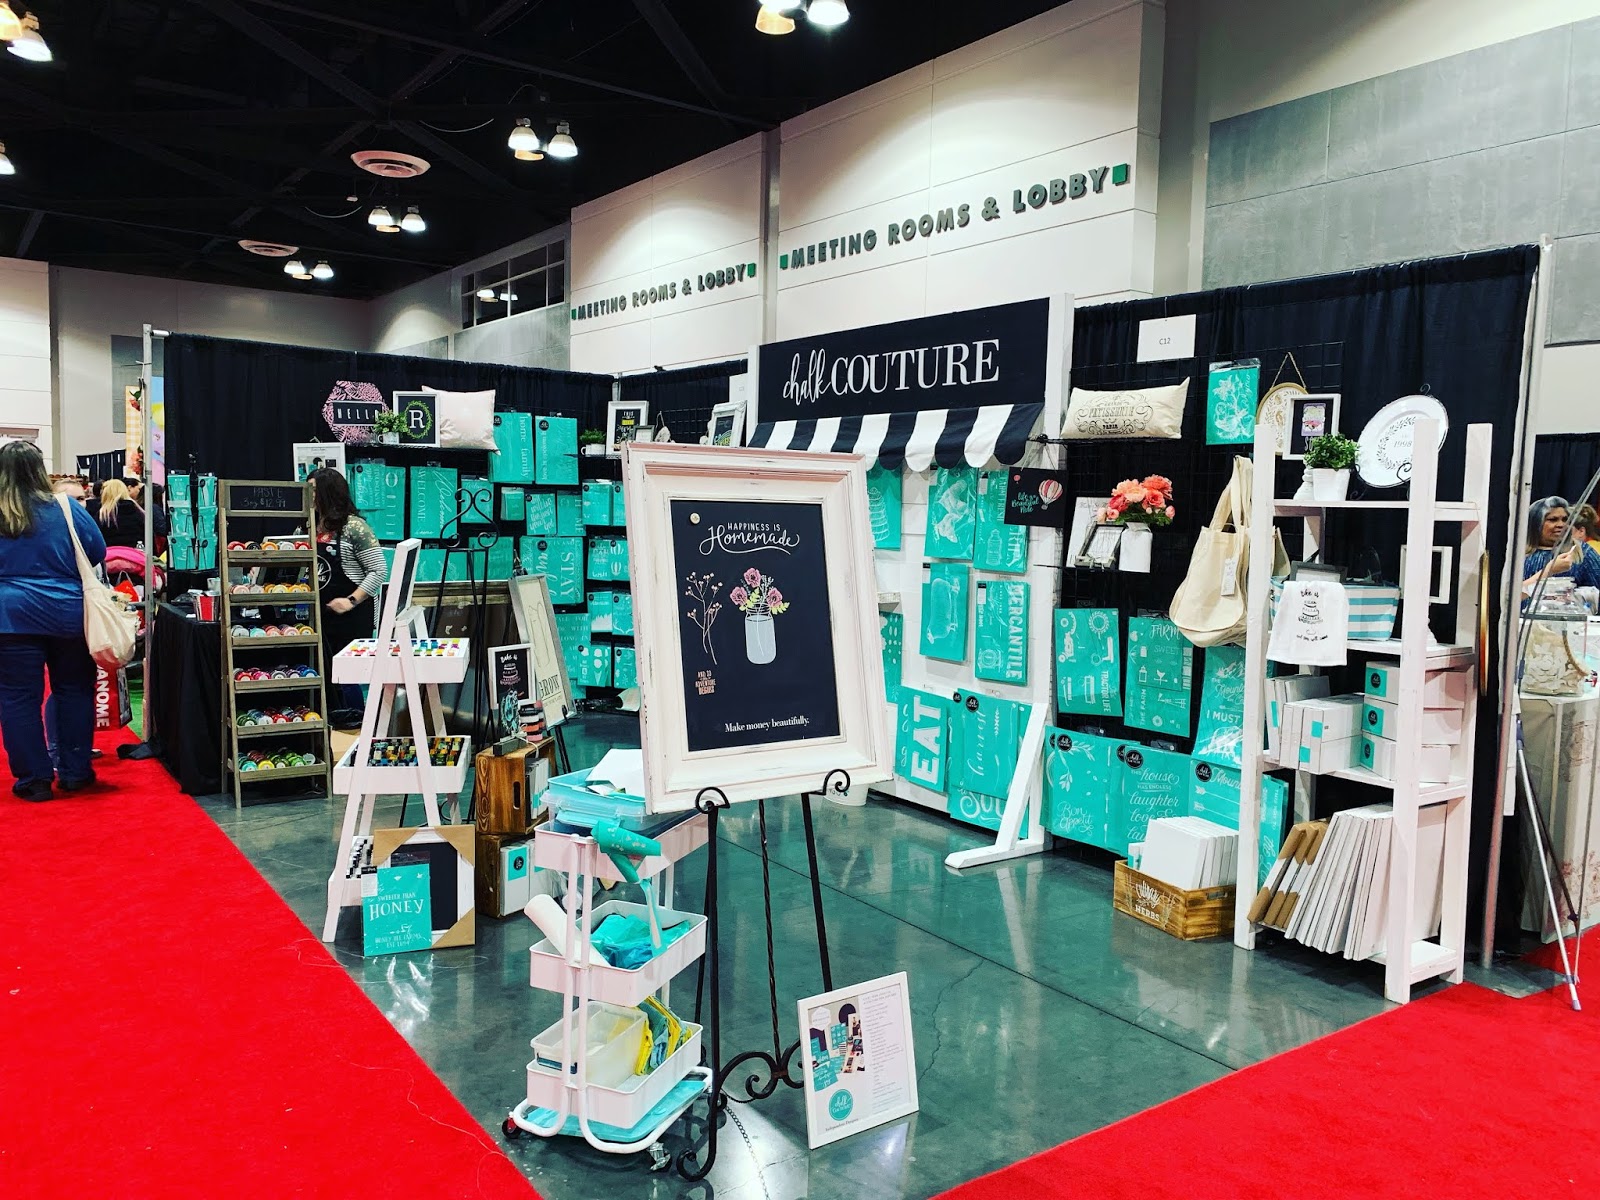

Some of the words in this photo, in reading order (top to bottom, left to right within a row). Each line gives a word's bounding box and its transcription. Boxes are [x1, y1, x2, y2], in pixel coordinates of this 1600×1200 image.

[790, 229, 878, 270] MEETING
[888, 203, 970, 246] ROOMS
[981, 196, 1001, 222] &
[1012, 166, 1110, 214] LOBBY
[577, 294, 627, 320] MEETING
[632, 282, 677, 308] ROOMS
[682, 278, 692, 296] &
[698, 263, 747, 292] LOBBY
[1159, 337, 1171, 345] C12
[782, 348, 831, 406] chalk
[830, 338, 1000, 396] COUTURE
[409, 409, 425, 429] R
[519, 416, 527, 442] home
[520, 448, 529, 479] family
[727, 522, 770, 532] HAPPINESS
[773, 523, 781, 531] IS
[699, 523, 800, 556] Homemade
[560, 552, 575, 598] STAY
[1005, 584, 1025, 679] MERCANTILE
[1150, 624, 1181, 641] FARM
[1101, 670, 1110, 698] TRACTOR
[1103, 699, 1112, 713] LIFE
[1211, 710, 1241, 724] MUST
[724, 721, 745, 733] Make
[746, 720, 770, 731] money
[771, 715, 810, 727] beautifully.
[910, 695, 942, 785] EAT
[1140, 767, 1181, 789] house
[1127, 790, 1180, 812] laughter
[369, 898, 425, 922] HONEY
[1135, 904, 1160, 922] HERBS
